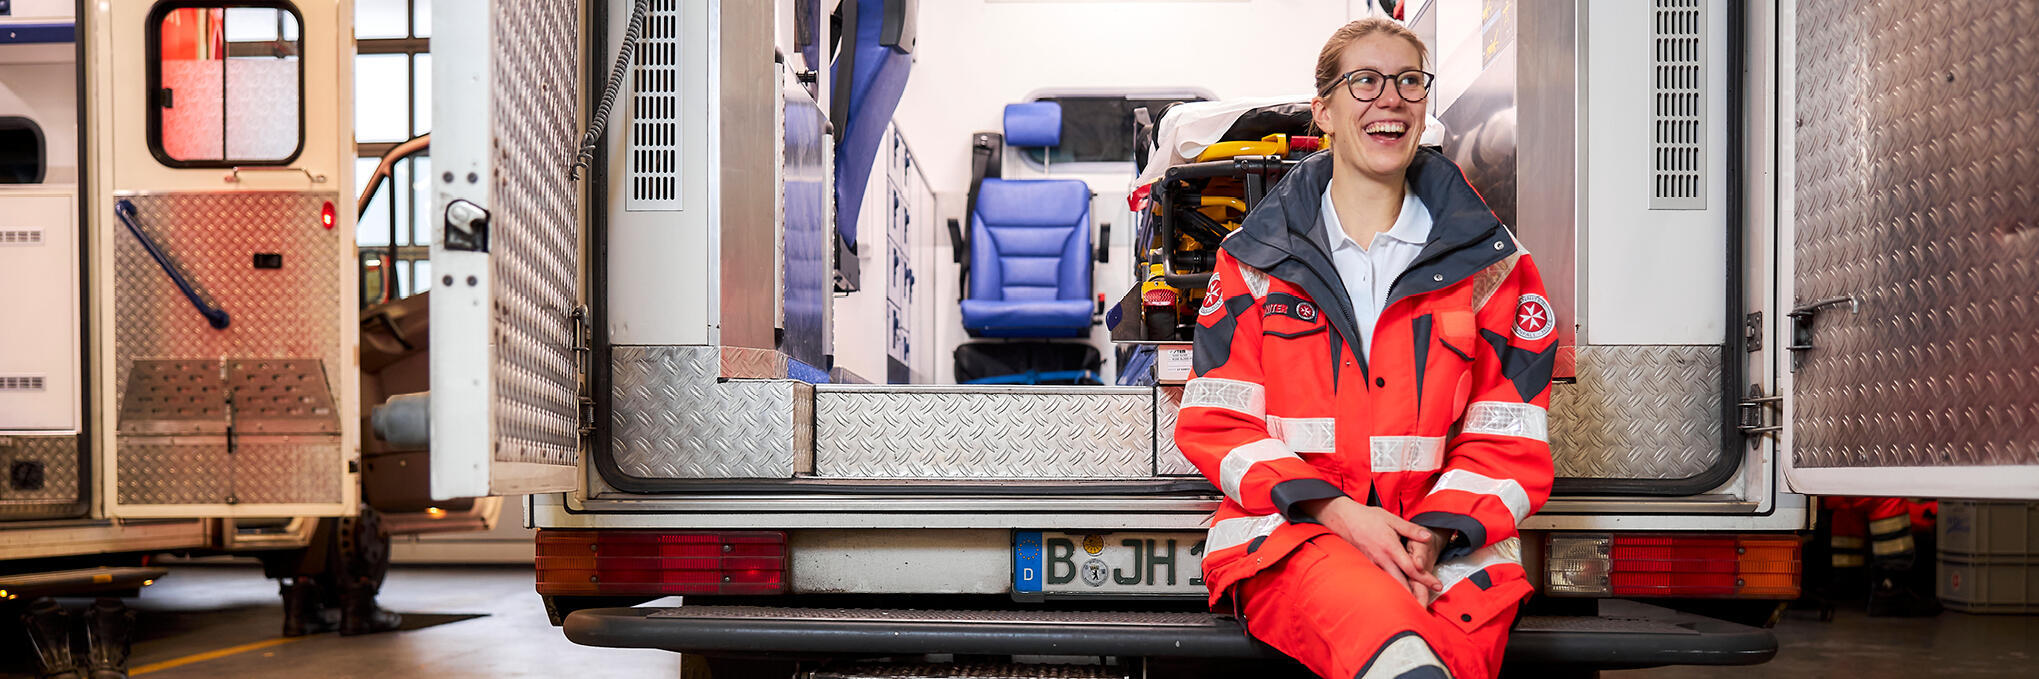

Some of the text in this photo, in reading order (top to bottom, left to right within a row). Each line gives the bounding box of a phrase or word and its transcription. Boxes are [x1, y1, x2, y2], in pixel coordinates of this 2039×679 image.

[1023, 568, 1034, 581] D
[1047, 538, 1077, 585] B
[1113, 539, 1176, 586] JH
